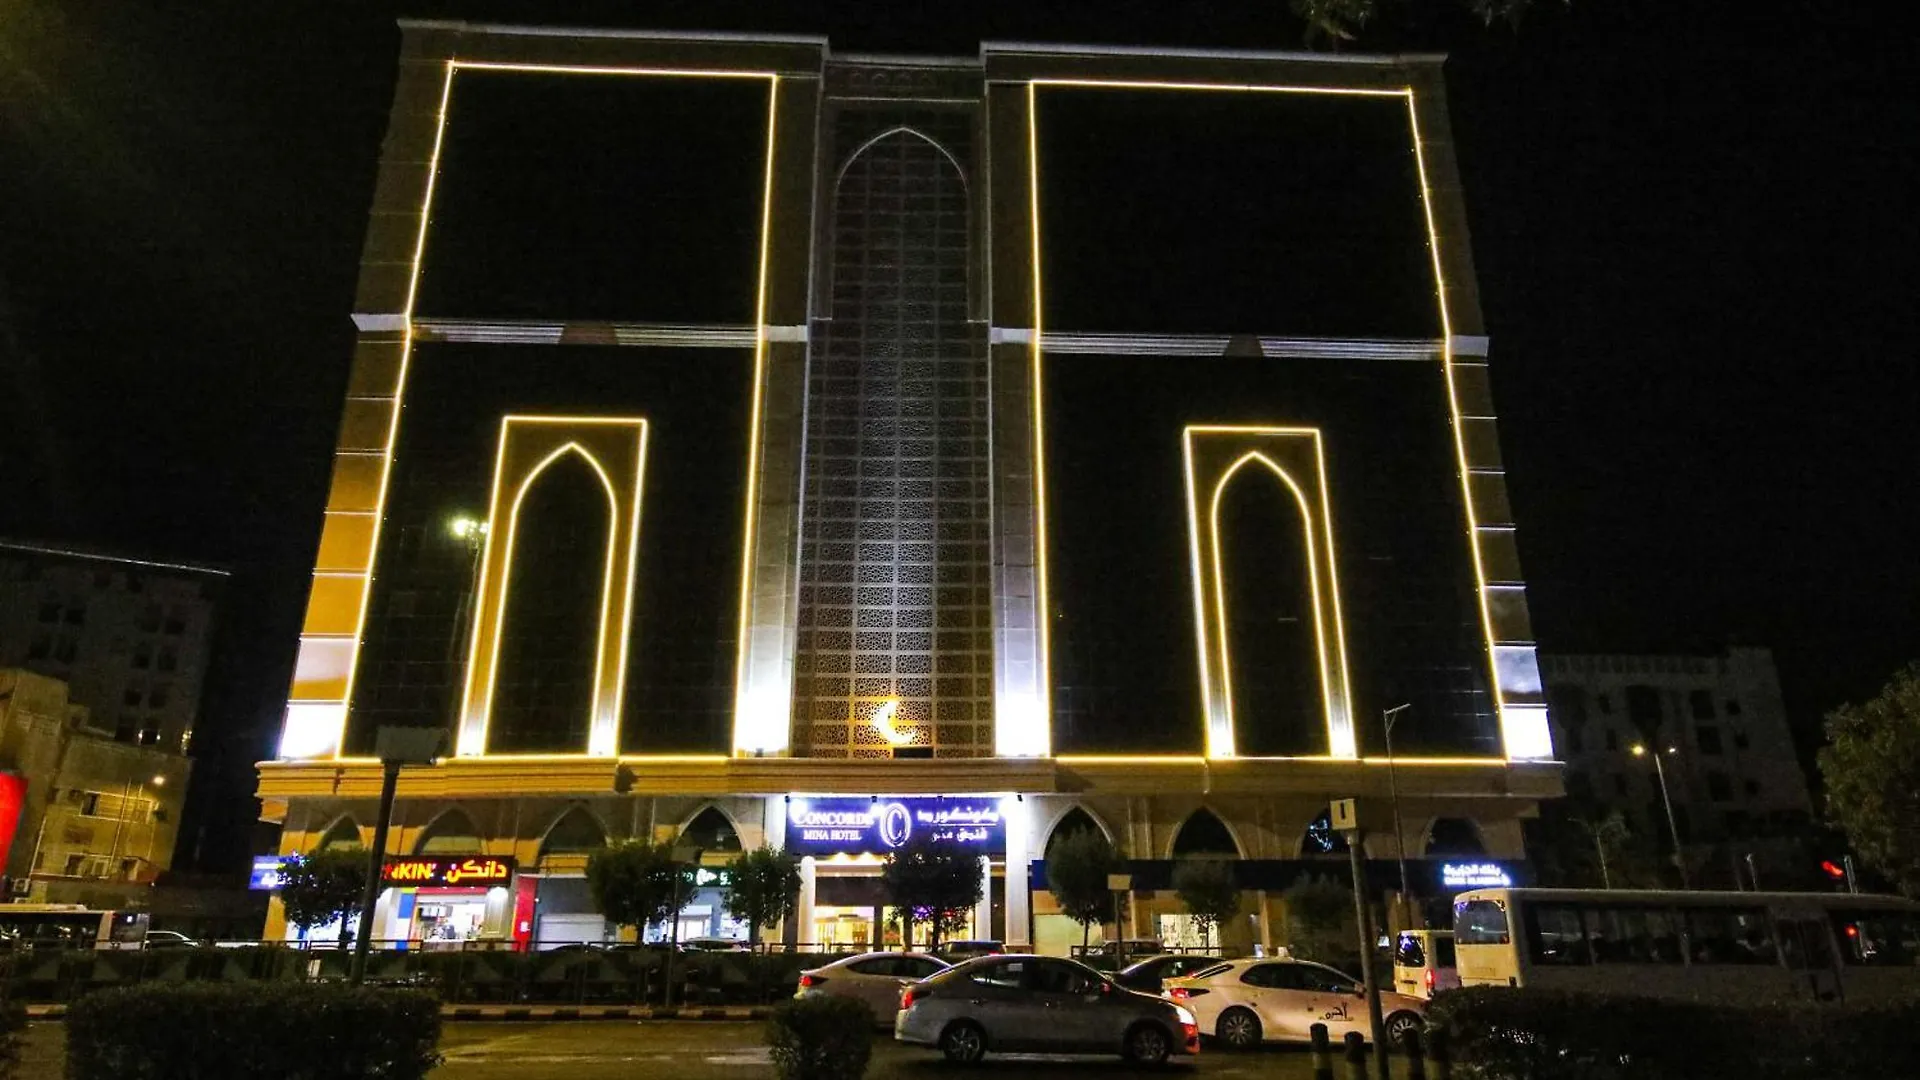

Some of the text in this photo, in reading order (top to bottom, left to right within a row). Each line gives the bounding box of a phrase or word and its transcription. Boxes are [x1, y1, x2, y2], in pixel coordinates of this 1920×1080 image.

[803, 829, 862, 841] MINA HOTEL
[446, 859, 507, 883] دانكن
